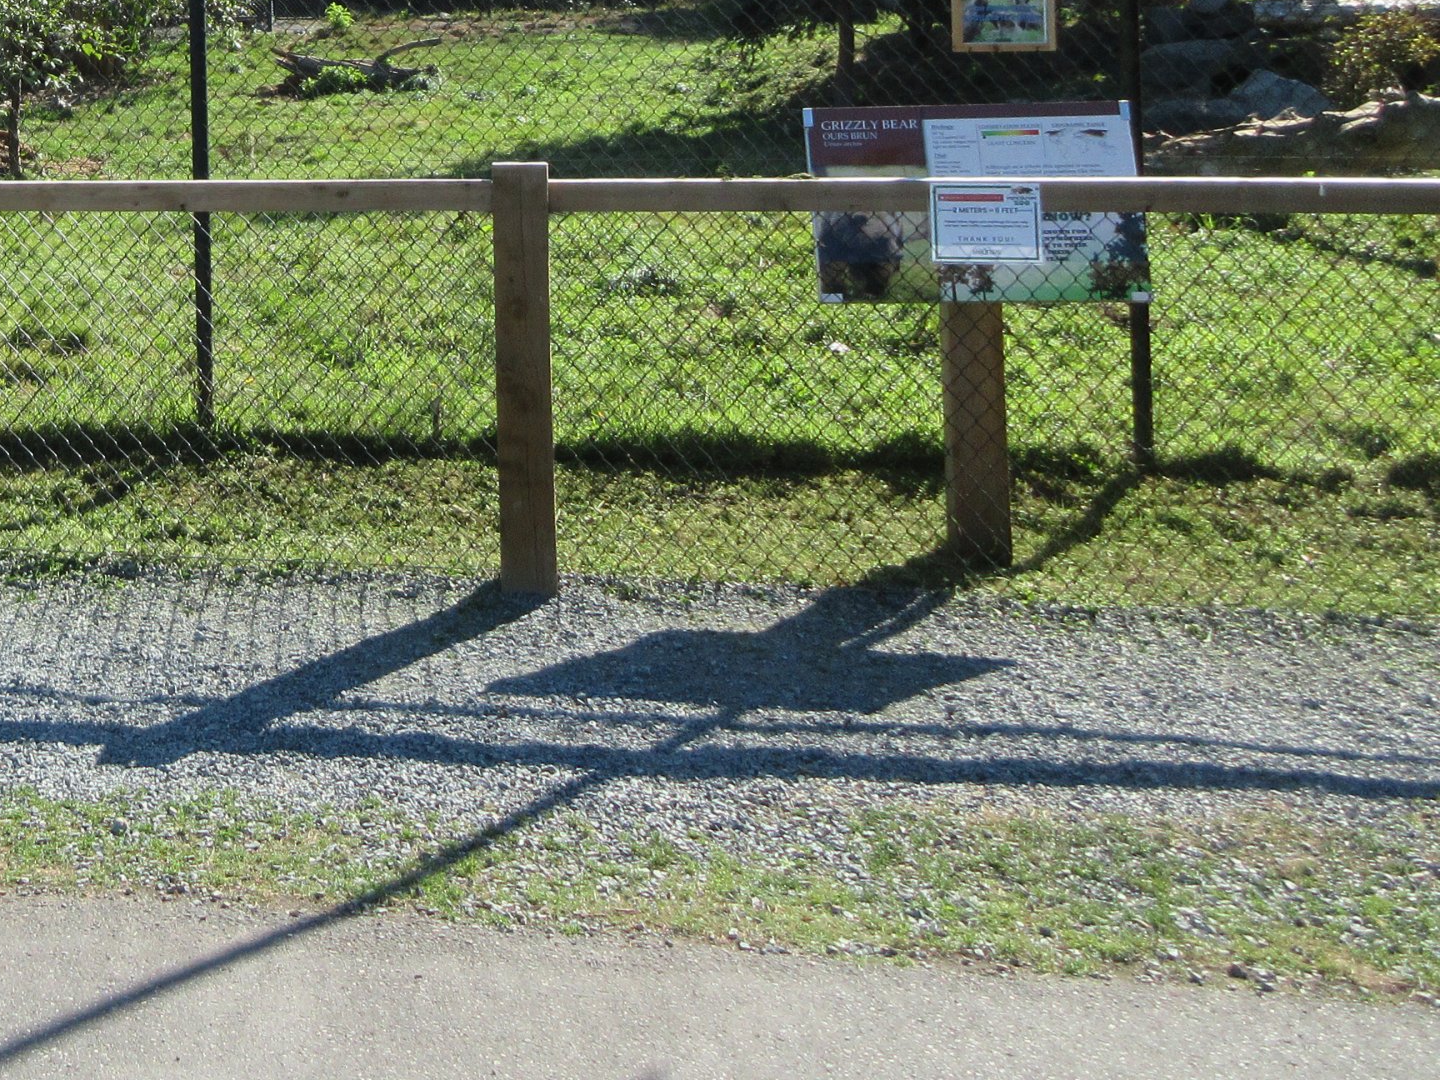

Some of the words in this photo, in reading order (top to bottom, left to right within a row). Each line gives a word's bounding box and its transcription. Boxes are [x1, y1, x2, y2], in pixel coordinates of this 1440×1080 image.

[821, 120, 880, 131] GRIZZLY
[882, 119, 918, 130] BEAR
[822, 132, 849, 140] OURS
[850, 131, 878, 139] BRUN
